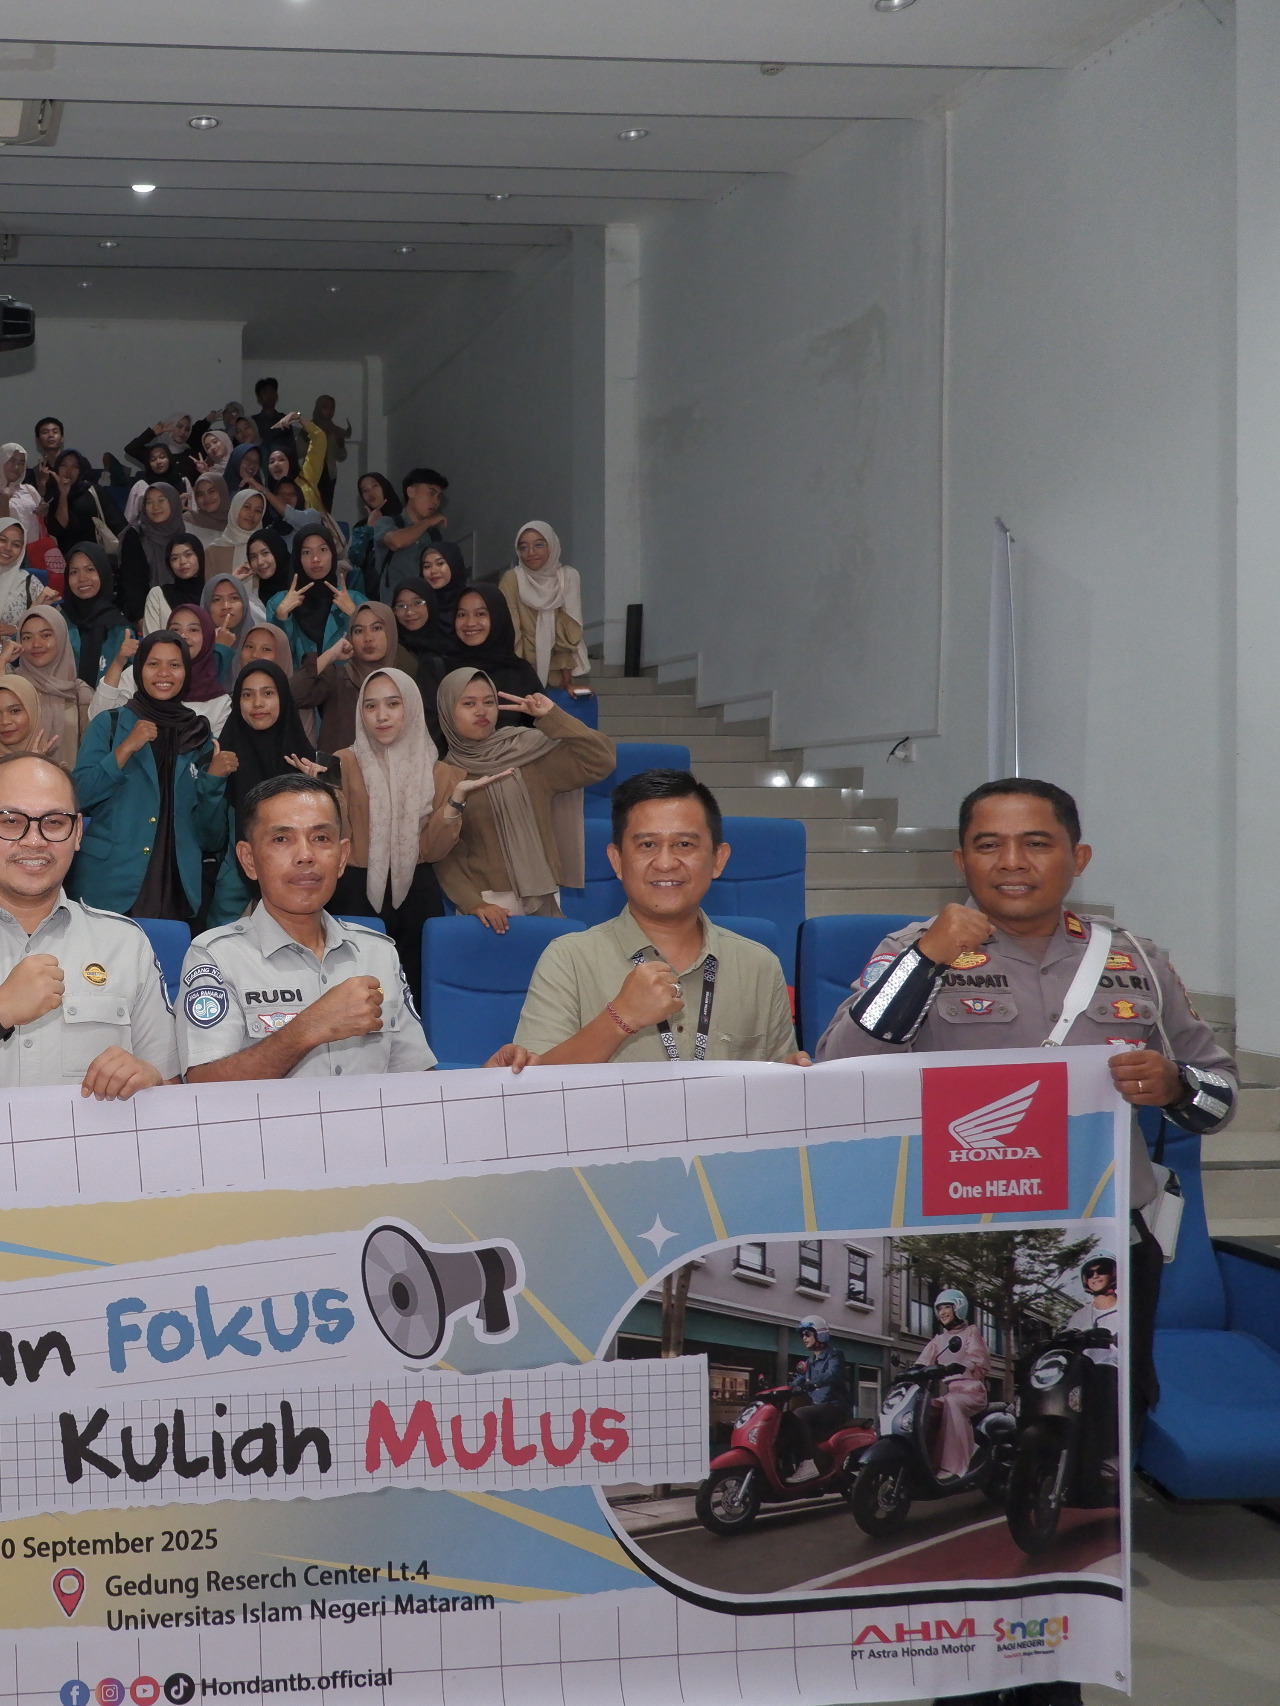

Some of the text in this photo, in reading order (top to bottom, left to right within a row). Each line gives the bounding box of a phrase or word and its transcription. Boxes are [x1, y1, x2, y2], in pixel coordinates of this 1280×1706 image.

[1099, 975, 1150, 991] OLRI
[245, 988, 303, 1005] RUDI
[949, 1146, 1042, 1162] HONDA
[948, 1178, 1043, 1199] One HEART.
[23, 1531, 155, 1562] September
[161, 1528, 218, 1552] 2025
[105, 1559, 430, 1599] Gedung Reserch Center Lt.4
[106, 1593, 495, 1632] Universitas Islam Negeri Mataram
[851, 1618, 975, 1645] AHM
[851, 1643, 976, 1660] PT Astra Honda Motor
[201, 1667, 393, 1697] Hondantb.official
